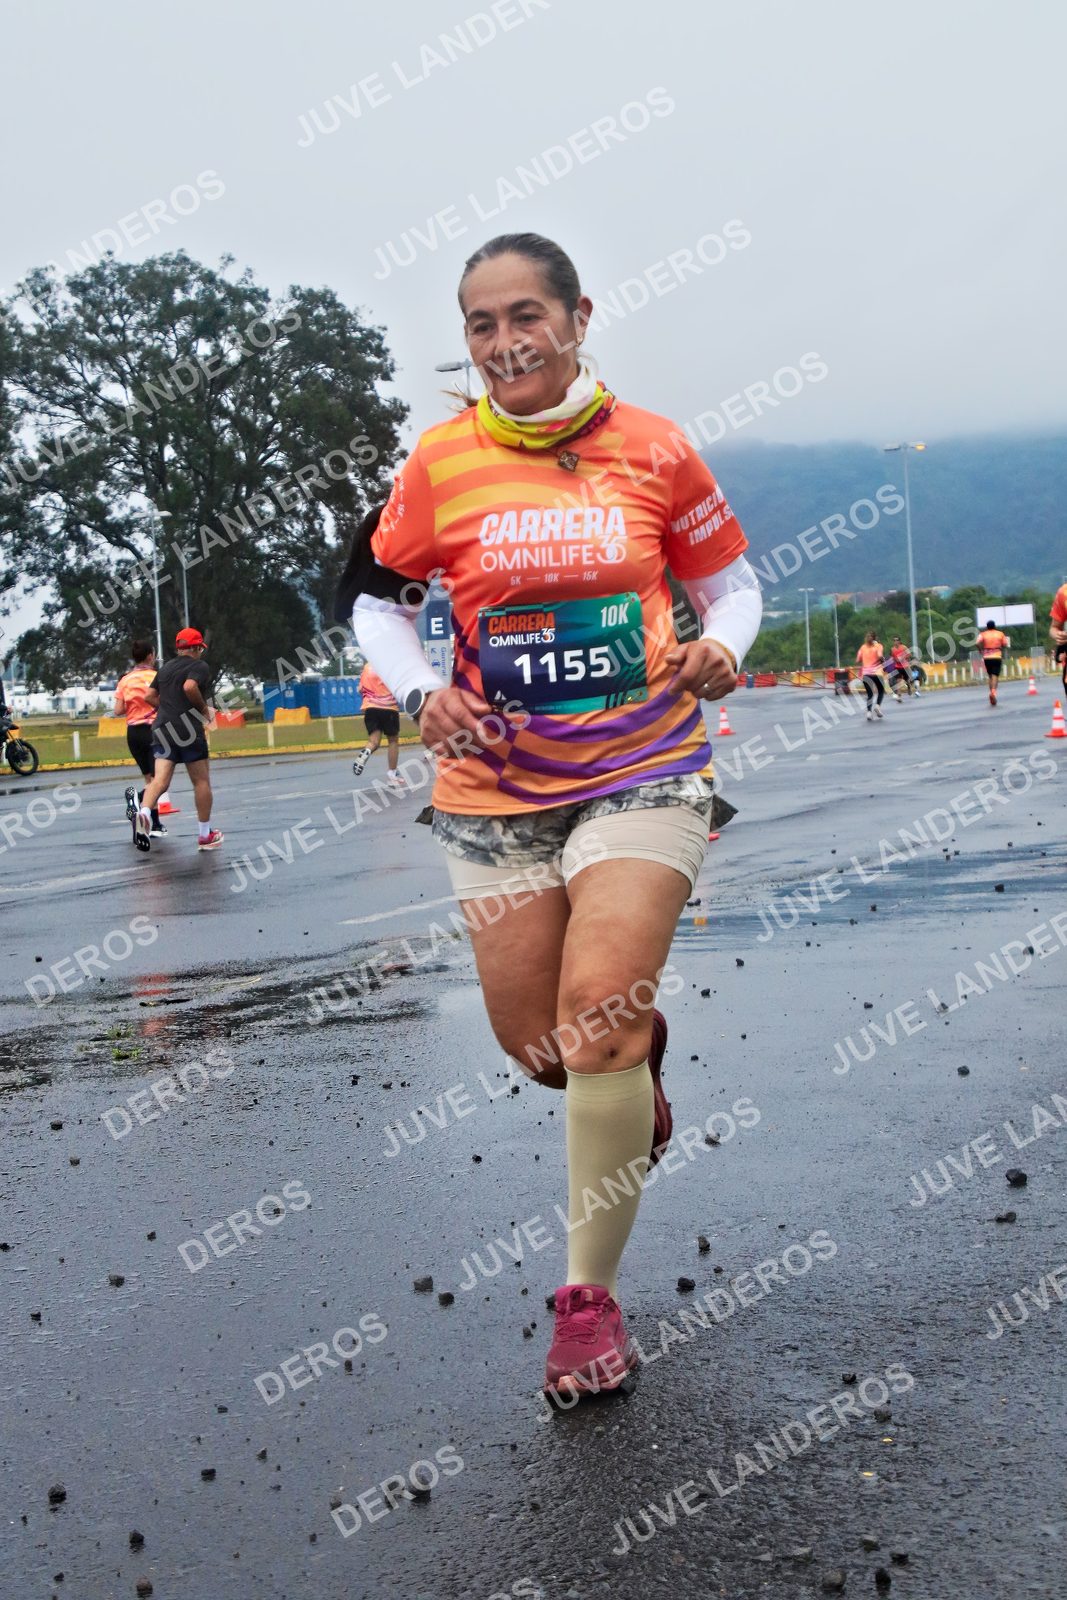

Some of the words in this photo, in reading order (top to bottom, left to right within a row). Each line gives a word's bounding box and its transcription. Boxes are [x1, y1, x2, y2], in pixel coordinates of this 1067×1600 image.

[479, 506, 626, 546] CARRERA
[431, 617, 444, 635] E
[488, 612, 556, 634] CARRERA
[601, 602, 629, 628] 10K
[514, 645, 611, 685] 1155
